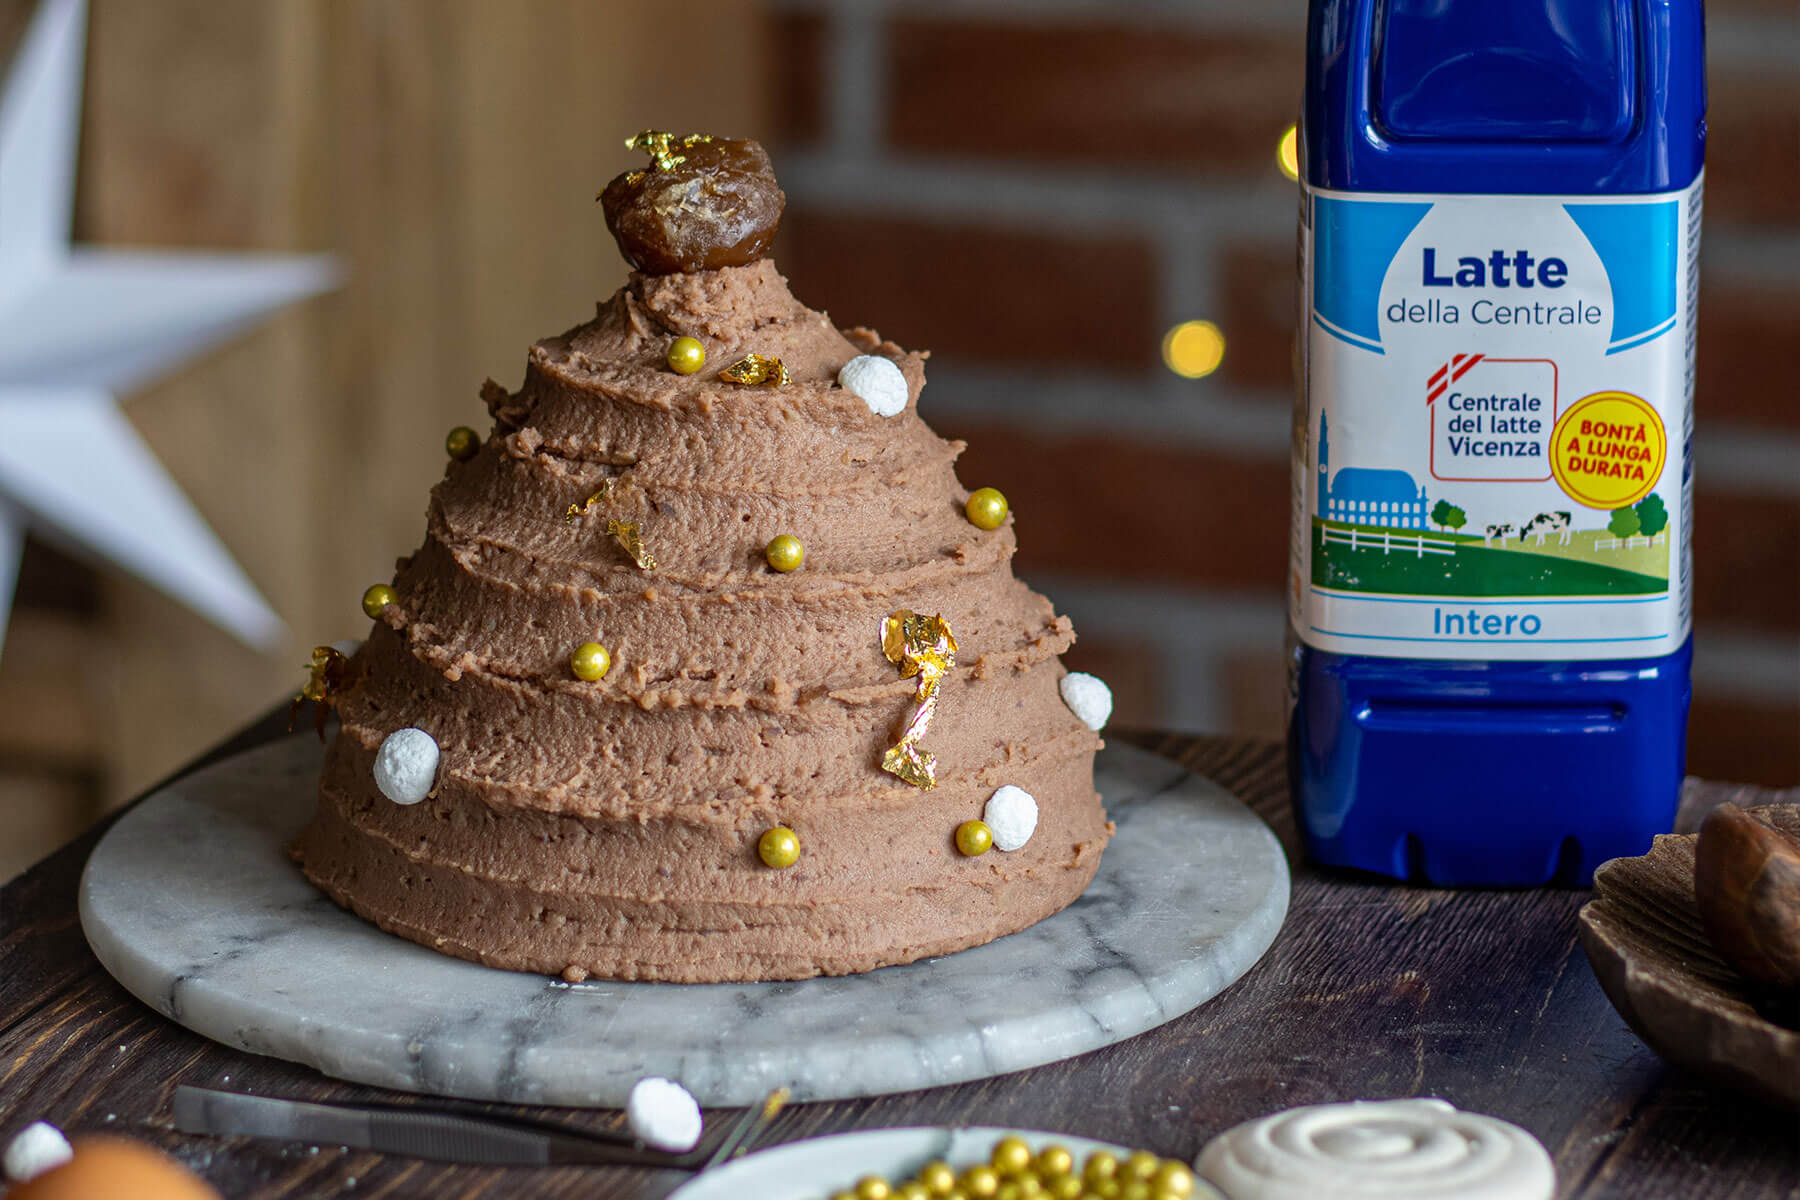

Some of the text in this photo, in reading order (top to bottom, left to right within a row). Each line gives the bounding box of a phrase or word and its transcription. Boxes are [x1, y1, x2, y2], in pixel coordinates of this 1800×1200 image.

[1423, 247, 1568, 288] Latte
[1387, 298, 1602, 325] della Centrale
[1448, 393, 1541, 412] Centrale
[1448, 415, 1541, 433] del latte
[1580, 420, 1646, 443] BONTÀ
[1448, 437, 1541, 456] Vicenza
[1567, 437, 1651, 463] A LUNGA
[1568, 457, 1645, 481] DURATA
[1433, 608, 1542, 635] Intero
